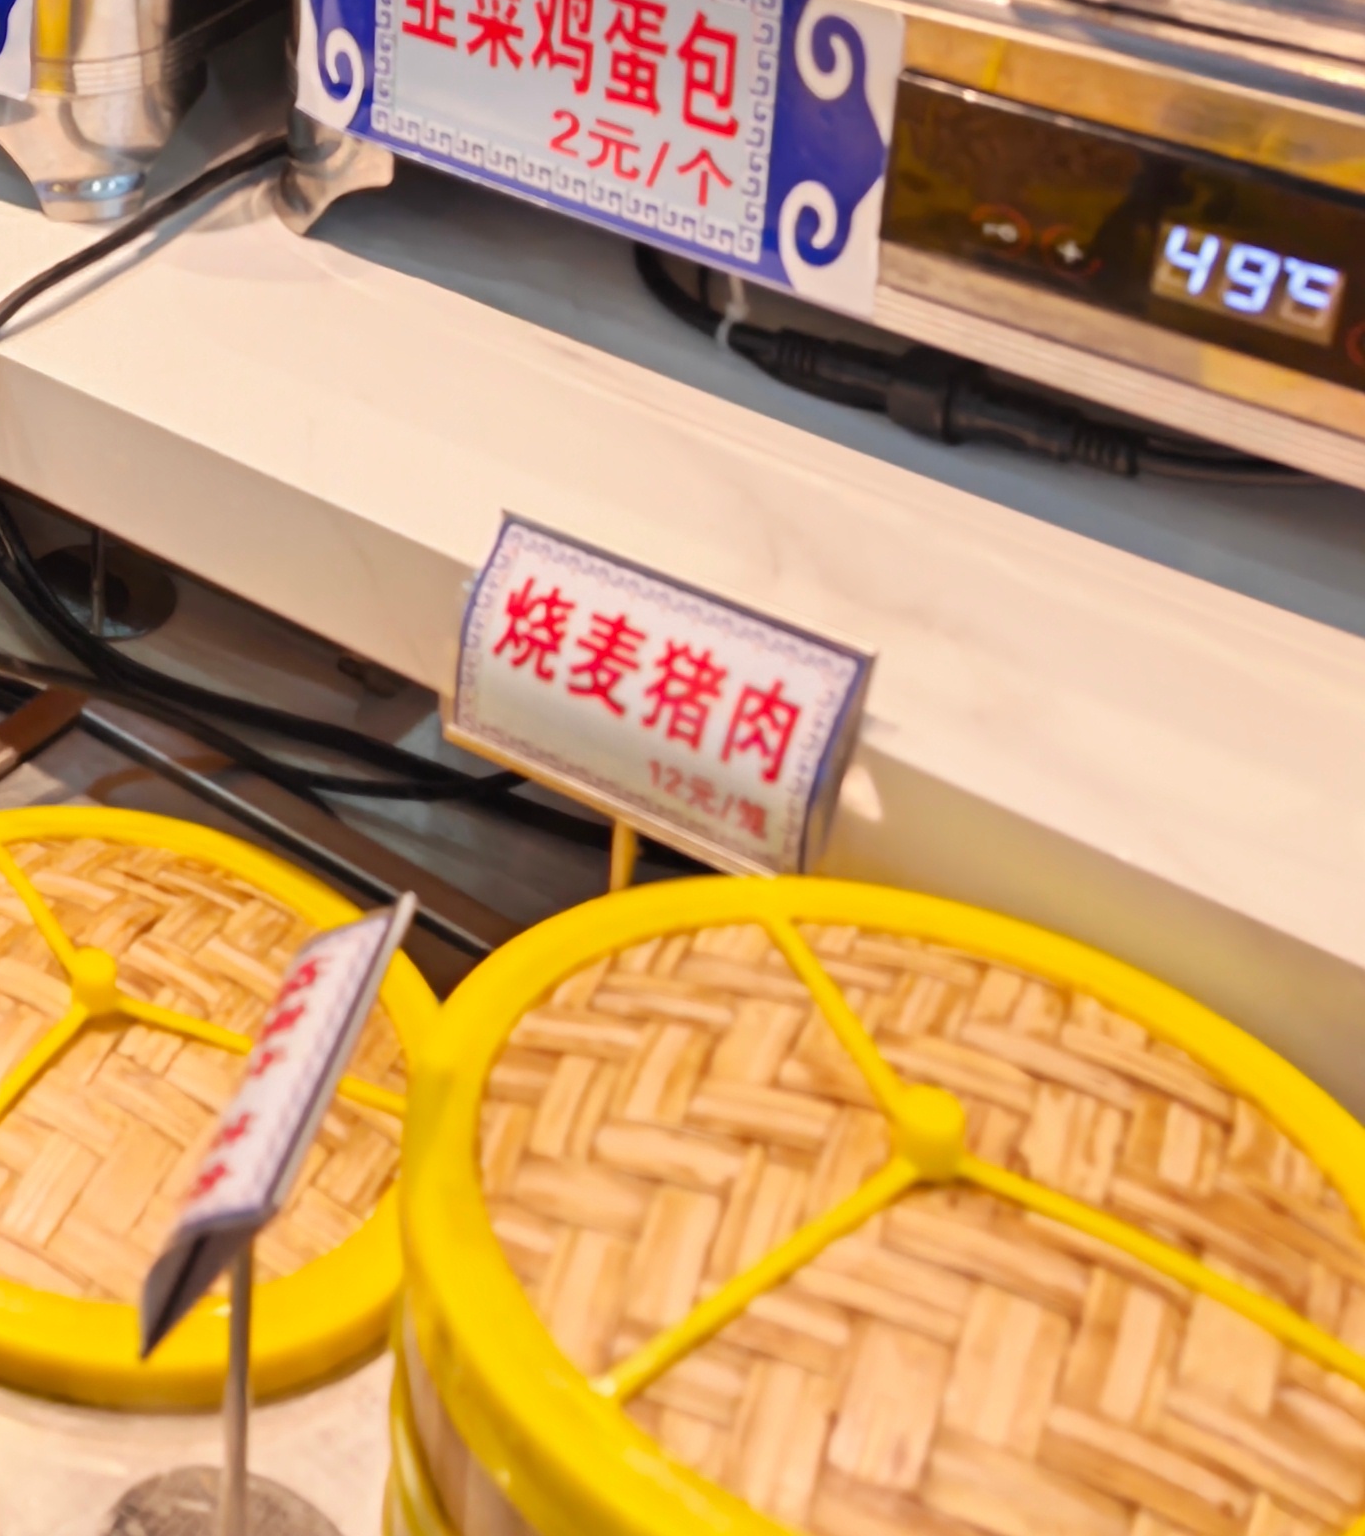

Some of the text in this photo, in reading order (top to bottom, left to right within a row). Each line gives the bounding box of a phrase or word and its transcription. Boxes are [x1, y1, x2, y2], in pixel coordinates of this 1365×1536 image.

[549, 108, 733, 208] 2元/个
[492, 576, 802, 784] 烧麦猪肉
